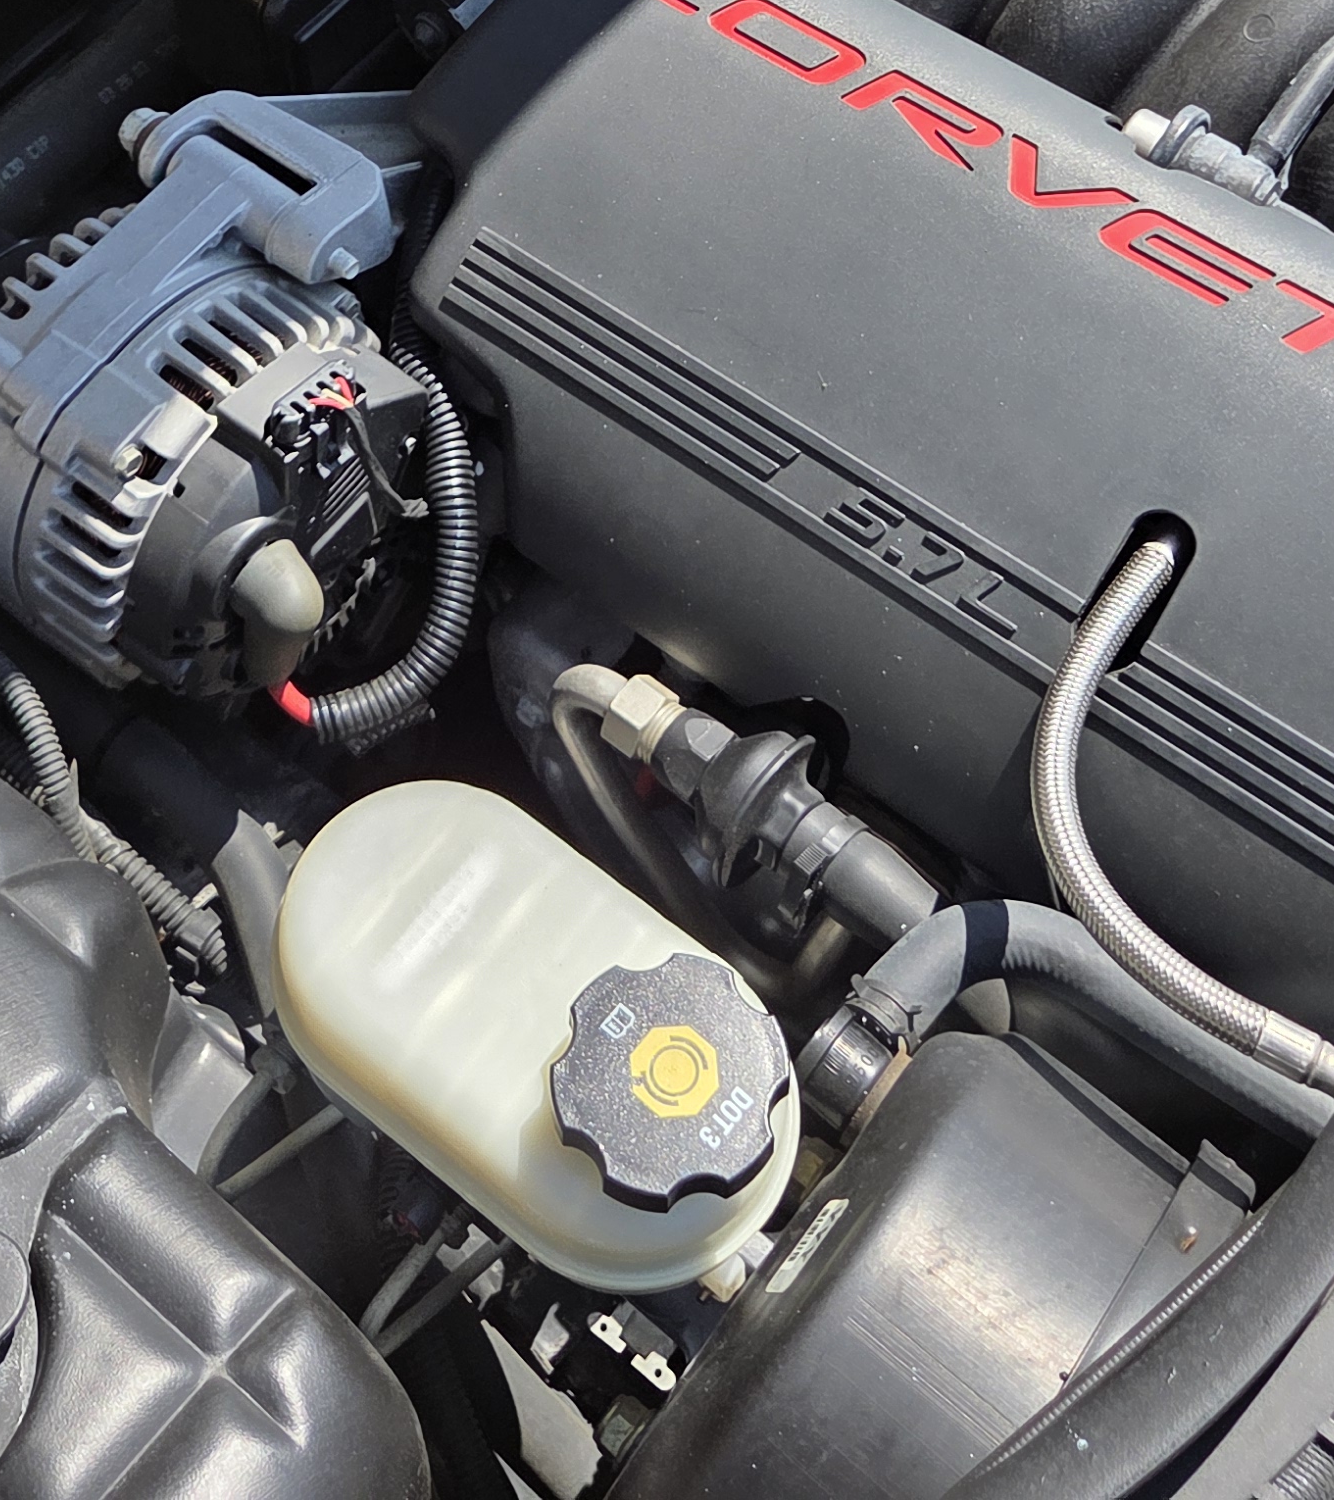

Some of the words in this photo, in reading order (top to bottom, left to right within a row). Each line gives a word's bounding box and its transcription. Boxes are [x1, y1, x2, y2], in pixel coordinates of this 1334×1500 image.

[822, 486, 1023, 639] 5.7L
[714, 1085, 755, 1137] DOT
[698, 1126, 722, 1150] 3
